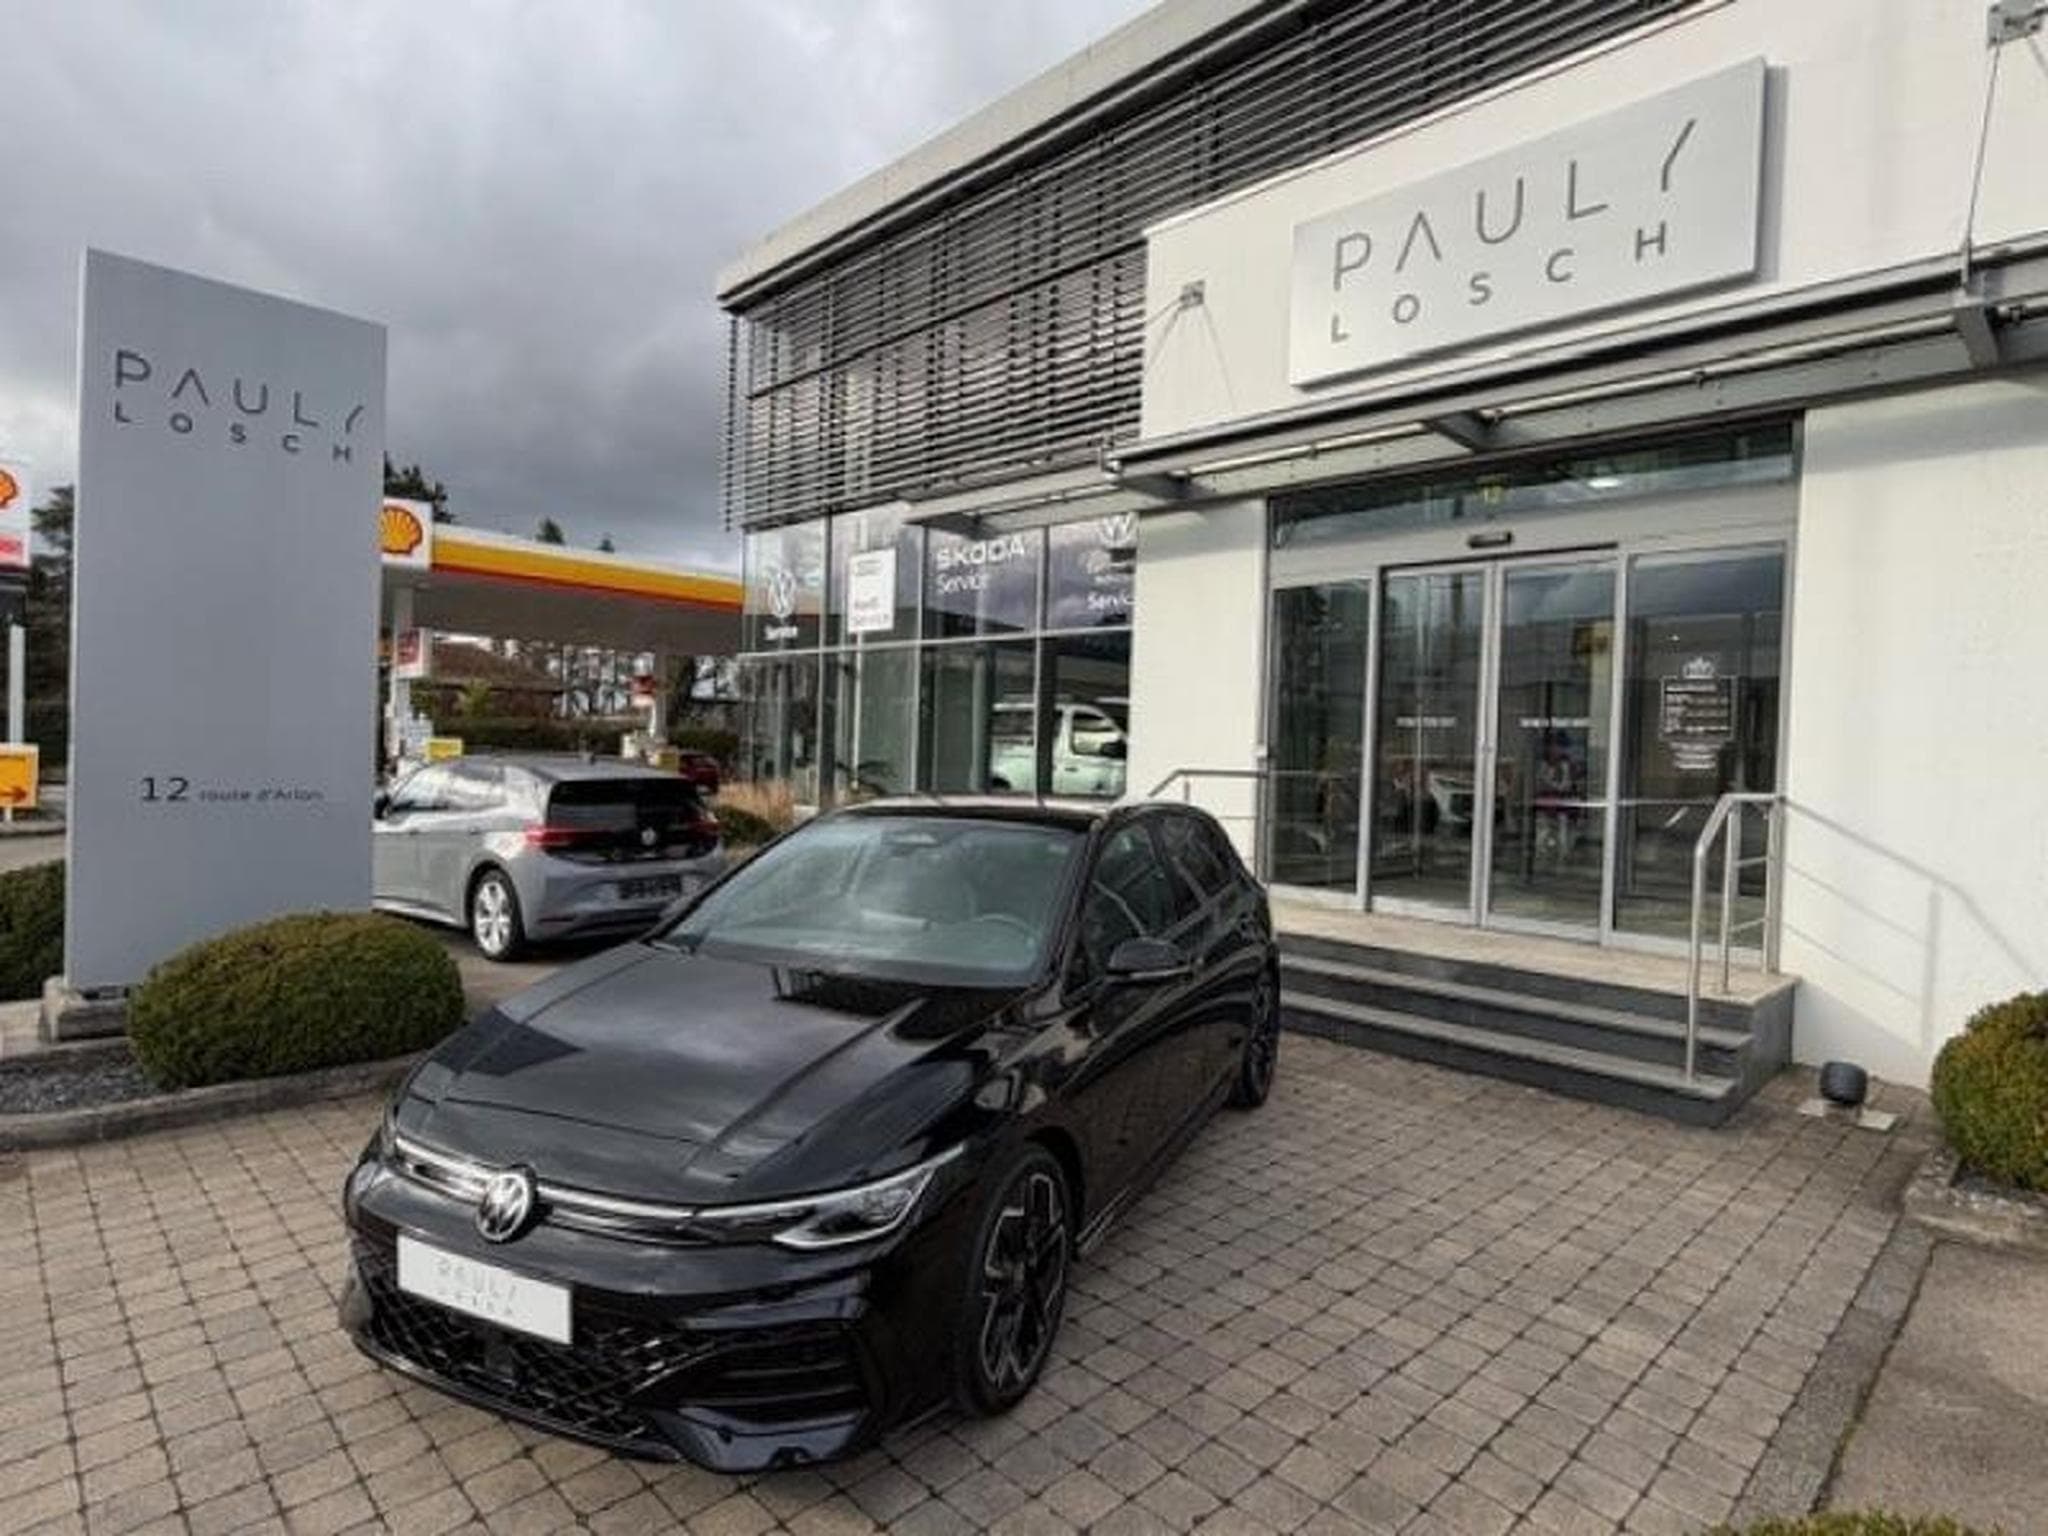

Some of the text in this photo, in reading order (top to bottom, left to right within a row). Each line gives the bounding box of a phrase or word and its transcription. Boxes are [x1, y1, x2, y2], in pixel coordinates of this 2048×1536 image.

[1333, 118, 1698, 291] PAULY
[1330, 222, 1668, 344] LOSCH
[115, 349, 365, 434] PAULY
[115, 401, 352, 463] LOSCH
[1087, 590, 1136, 611] Servic
[141, 777, 190, 802] 12
[200, 788, 251, 802] route
